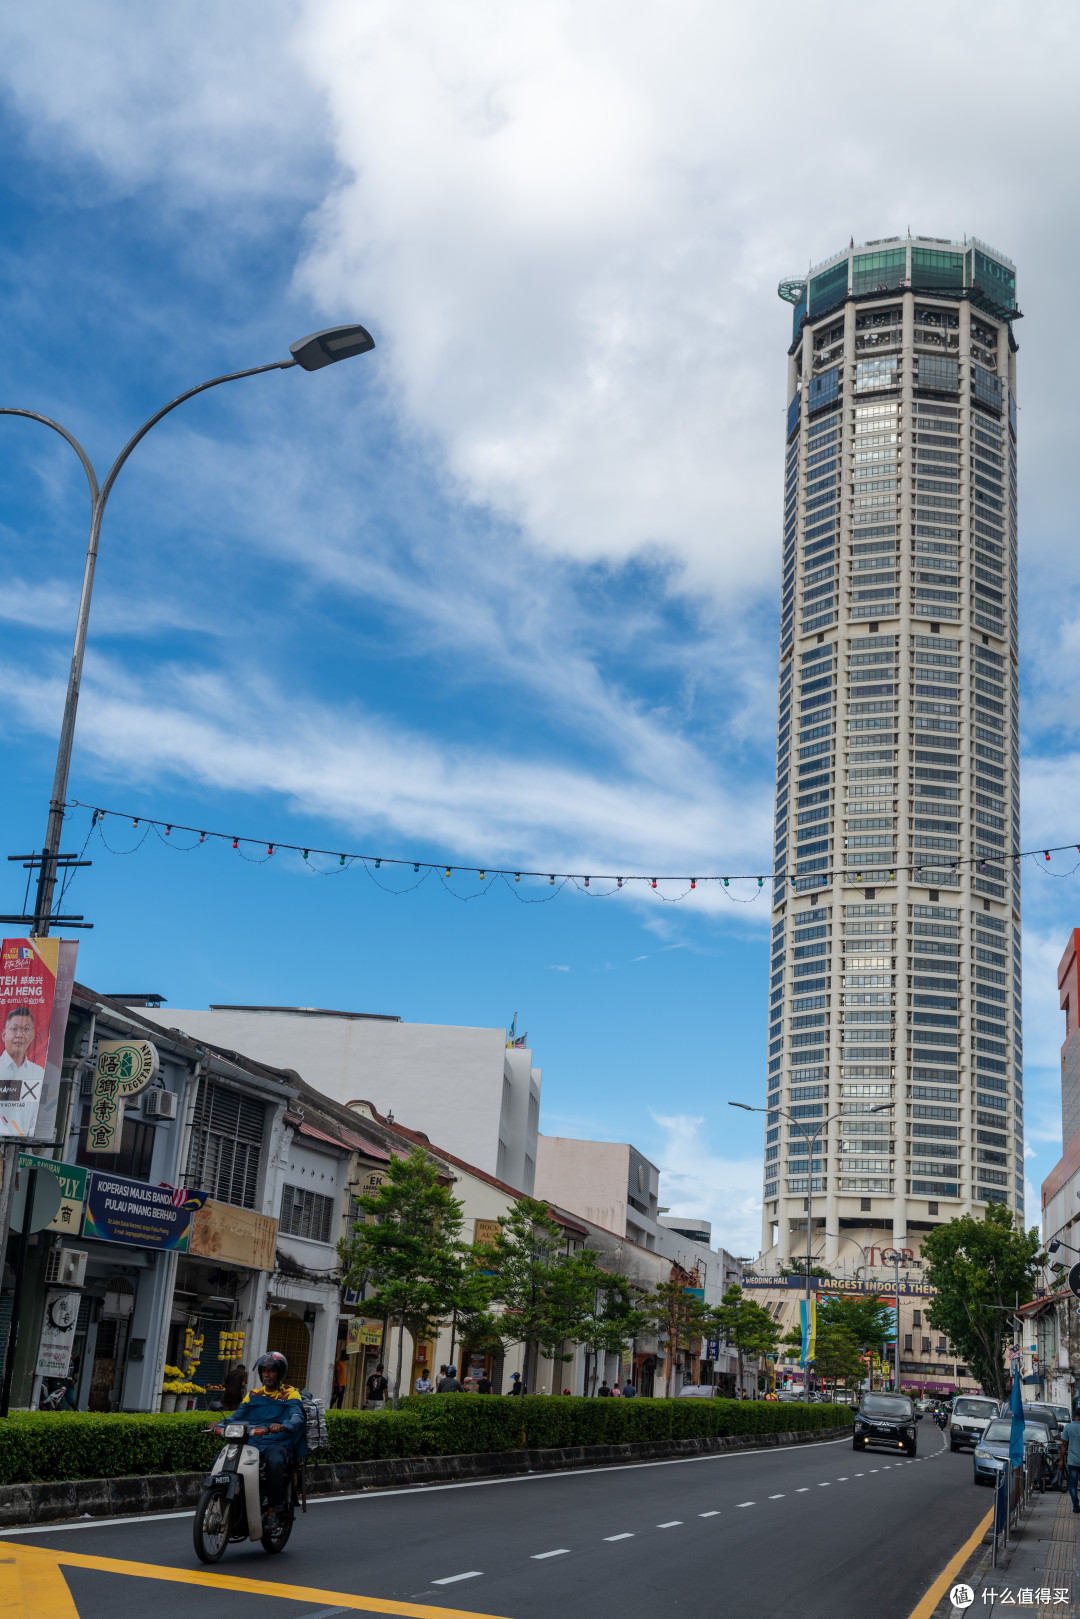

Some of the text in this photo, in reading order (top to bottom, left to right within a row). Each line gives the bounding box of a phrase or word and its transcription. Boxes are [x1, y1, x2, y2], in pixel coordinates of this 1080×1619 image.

[0, 976, 18, 986] TEH
[0, 986, 42, 996] LAI HENG
[122, 1044, 152, 1093] VEGETARIAN
[59, 1176, 80, 1198] PLY
[370, 1177, 382, 1185] EK
[97, 1181, 174, 1206] KOPERASI MAJLIS BANDA
[105, 1198, 176, 1221] PULAU PINANG BERHAD
[864, 1246, 914, 1268] TOP
[774, 1277, 788, 1285] HALL
[818, 1279, 940, 1295] LARGEST INDOOR THEM
